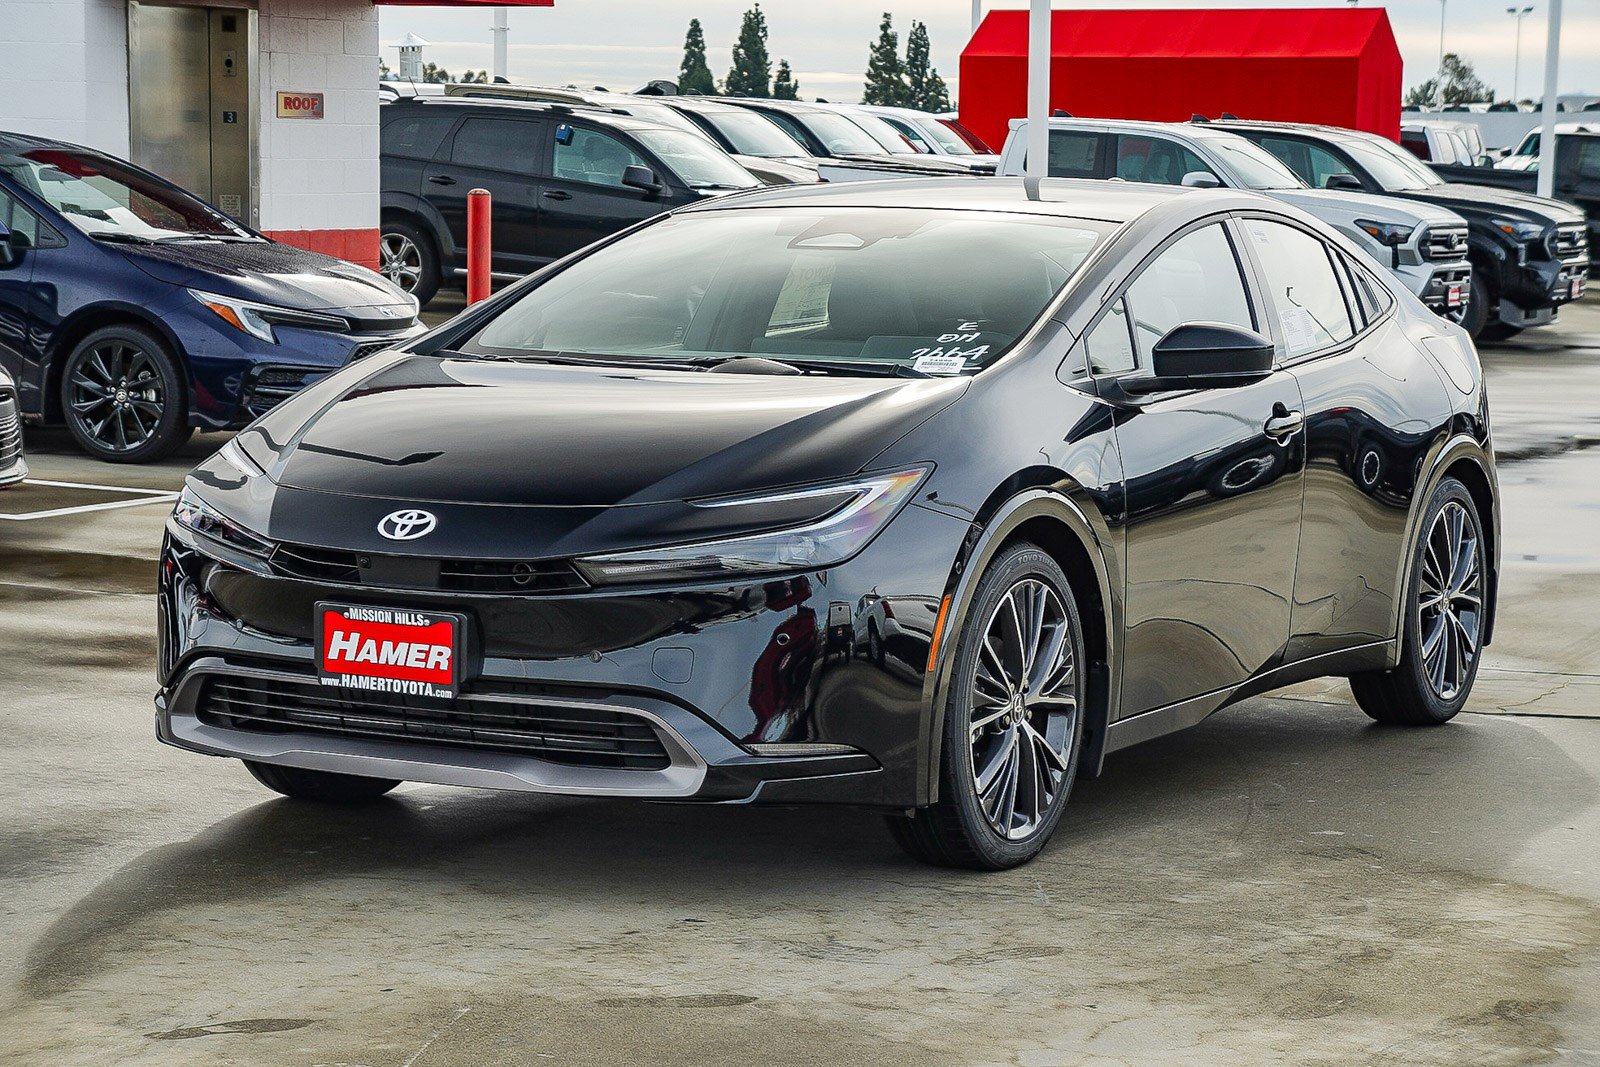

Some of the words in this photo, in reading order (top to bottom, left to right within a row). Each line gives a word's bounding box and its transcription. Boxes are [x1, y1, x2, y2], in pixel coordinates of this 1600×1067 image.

[284, 96, 319, 110] ROOF
[227, 112, 234, 123] 3
[349, 607, 392, 623] MISSION
[394, 612, 424, 626] HILLS
[327, 630, 452, 671] HAMER
[321, 673, 453, 699] www.HAMERTOYOTA.com
